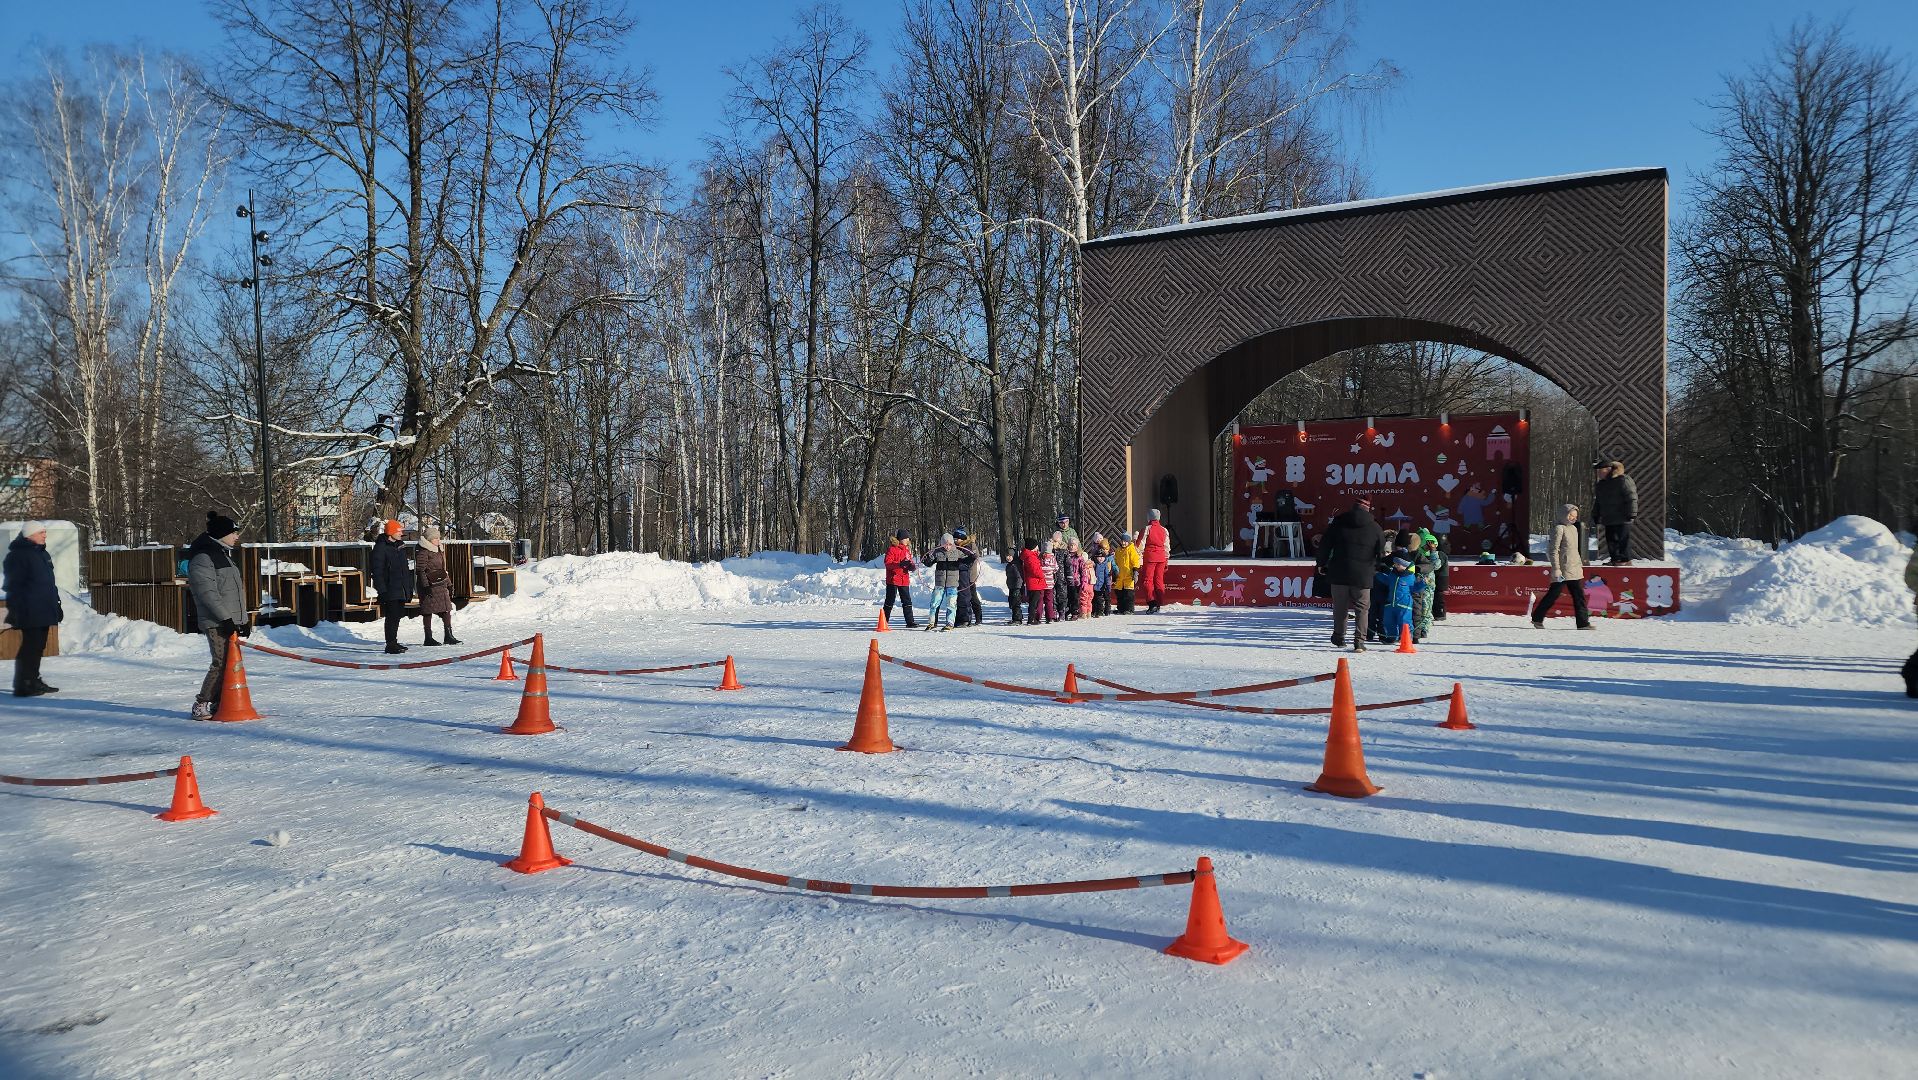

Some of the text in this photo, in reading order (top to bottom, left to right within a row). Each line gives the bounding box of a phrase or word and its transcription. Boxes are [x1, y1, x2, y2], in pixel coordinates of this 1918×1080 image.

[1325, 461, 1420, 486] ЗИМА
[1347, 487, 1405, 496] Подмосковье
[1264, 576, 1315, 599] ЗИ
[1285, 600, 1334, 608] Подмосков
